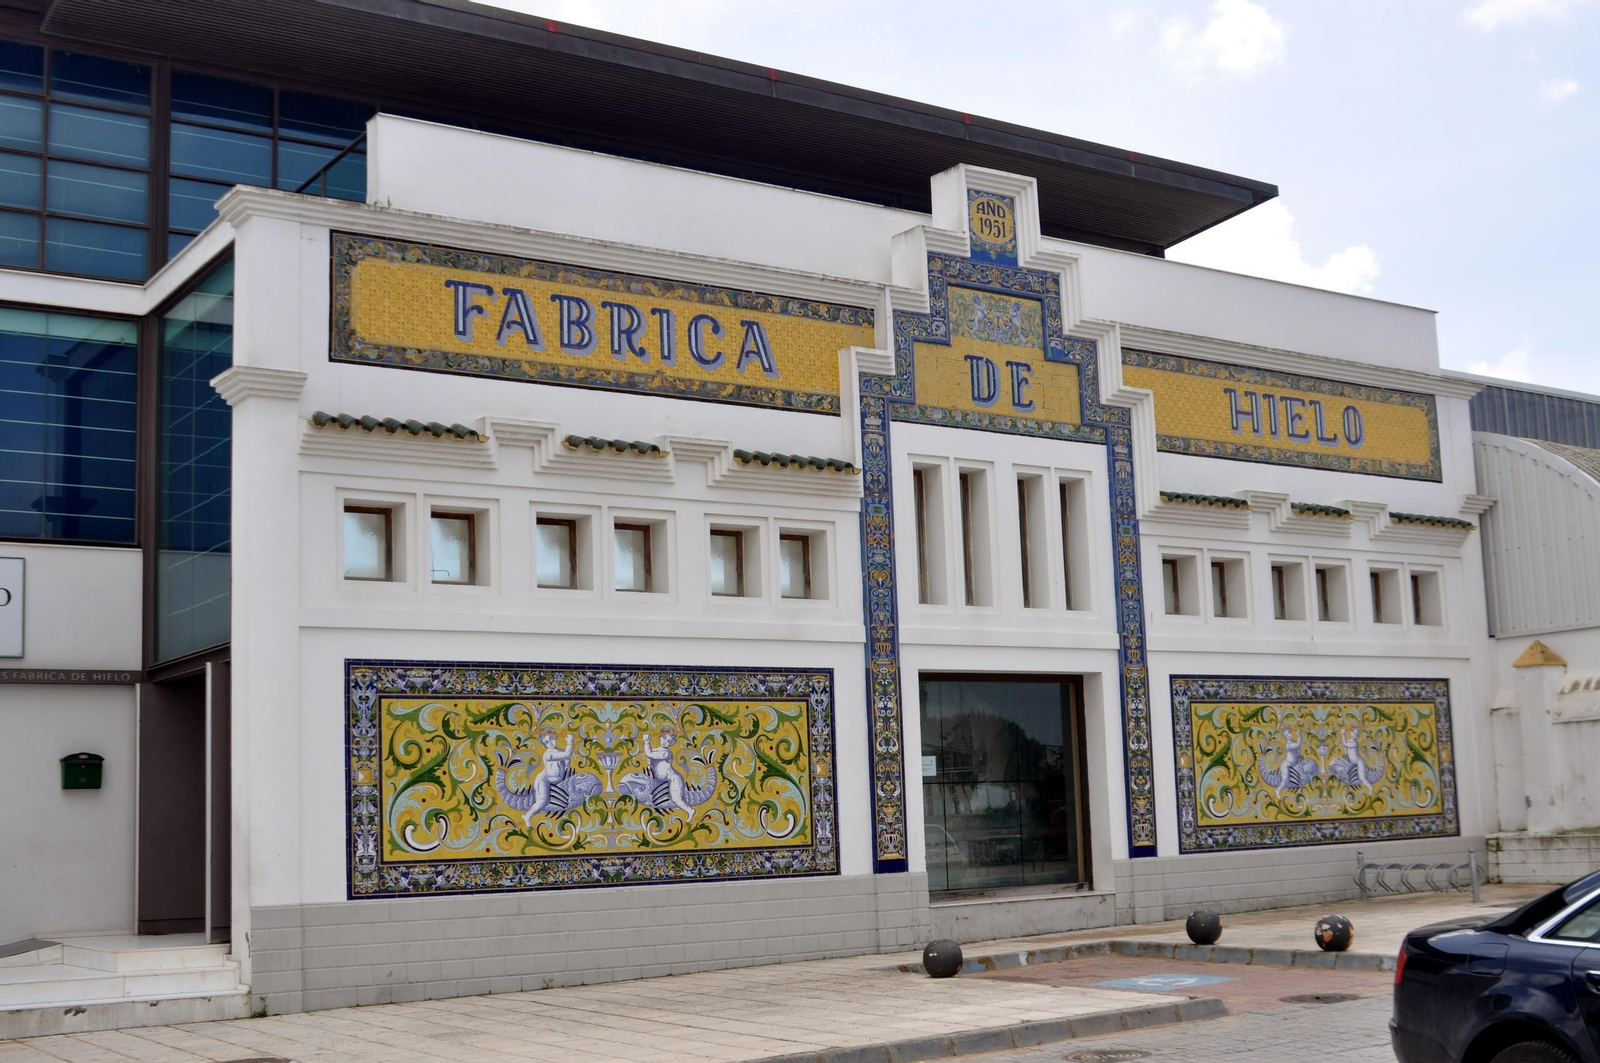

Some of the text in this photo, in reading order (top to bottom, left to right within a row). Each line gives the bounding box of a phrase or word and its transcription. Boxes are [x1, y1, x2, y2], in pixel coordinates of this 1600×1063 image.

[979, 217, 1006, 239] 1951
[445, 279, 780, 379] FABRICA
[963, 354, 1037, 413] DE
[1223, 387, 1365, 450] HIELO
[12, 671, 66, 681] FABRICA
[71, 672, 88, 681] DE
[93, 672, 131, 682] HIELO
